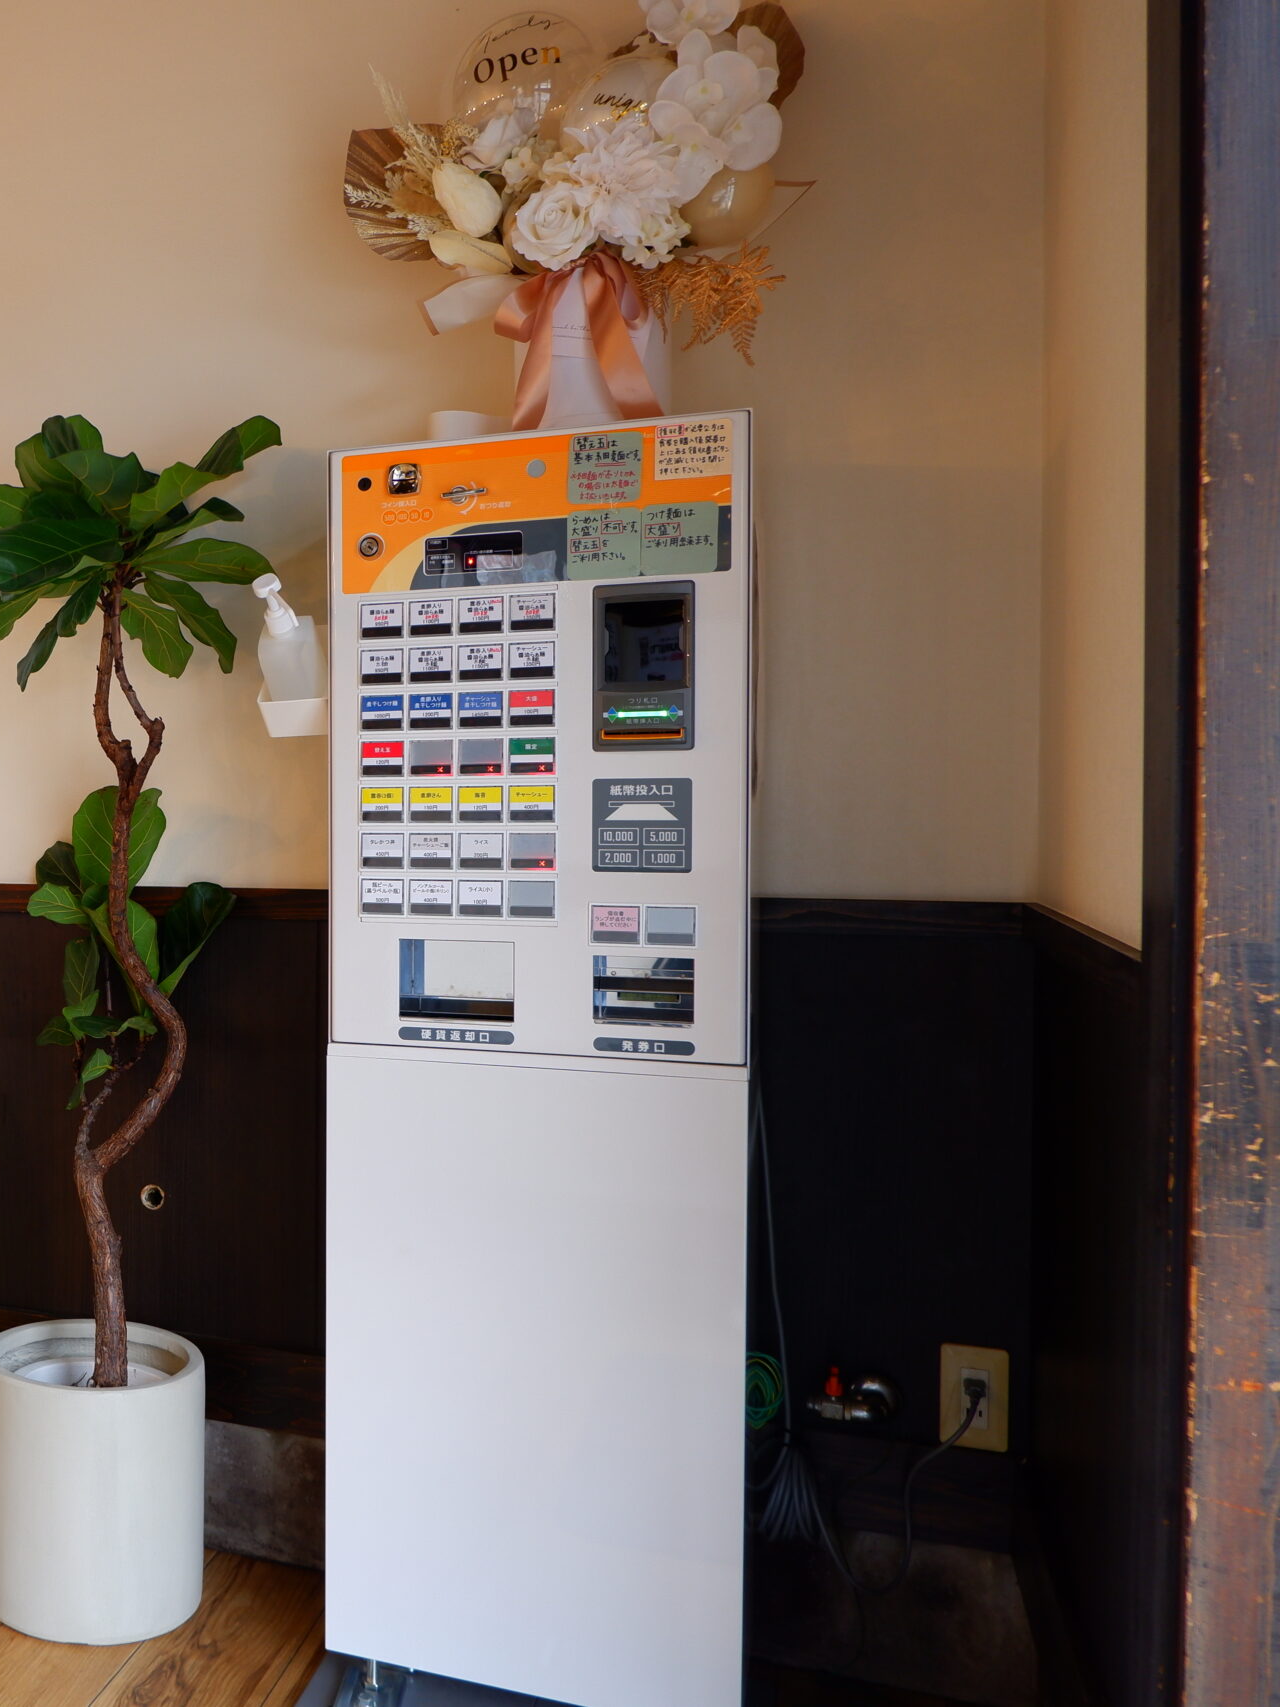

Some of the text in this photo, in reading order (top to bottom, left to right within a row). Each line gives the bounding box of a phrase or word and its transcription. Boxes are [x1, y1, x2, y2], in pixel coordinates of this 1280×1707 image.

[473, 46, 562, 84] Open
[571, 513, 610, 525] らーめんは
[647, 507, 696, 521] つけ麺は
[571, 520, 638, 537] 大盛り不可です。
[646, 523, 680, 537] 大盛り
[571, 552, 627, 564] ご利用下さい。
[609, 784, 674, 796] 紙幣投入口
[603, 831, 634, 843] 10,000
[650, 832, 678, 843] 5,000
[605, 852, 632, 864] 2,000
[650, 853, 676, 864] 1,000
[421, 1028, 490, 1042] 硬貨返却口
[622, 1040, 666, 1053] 発券口
